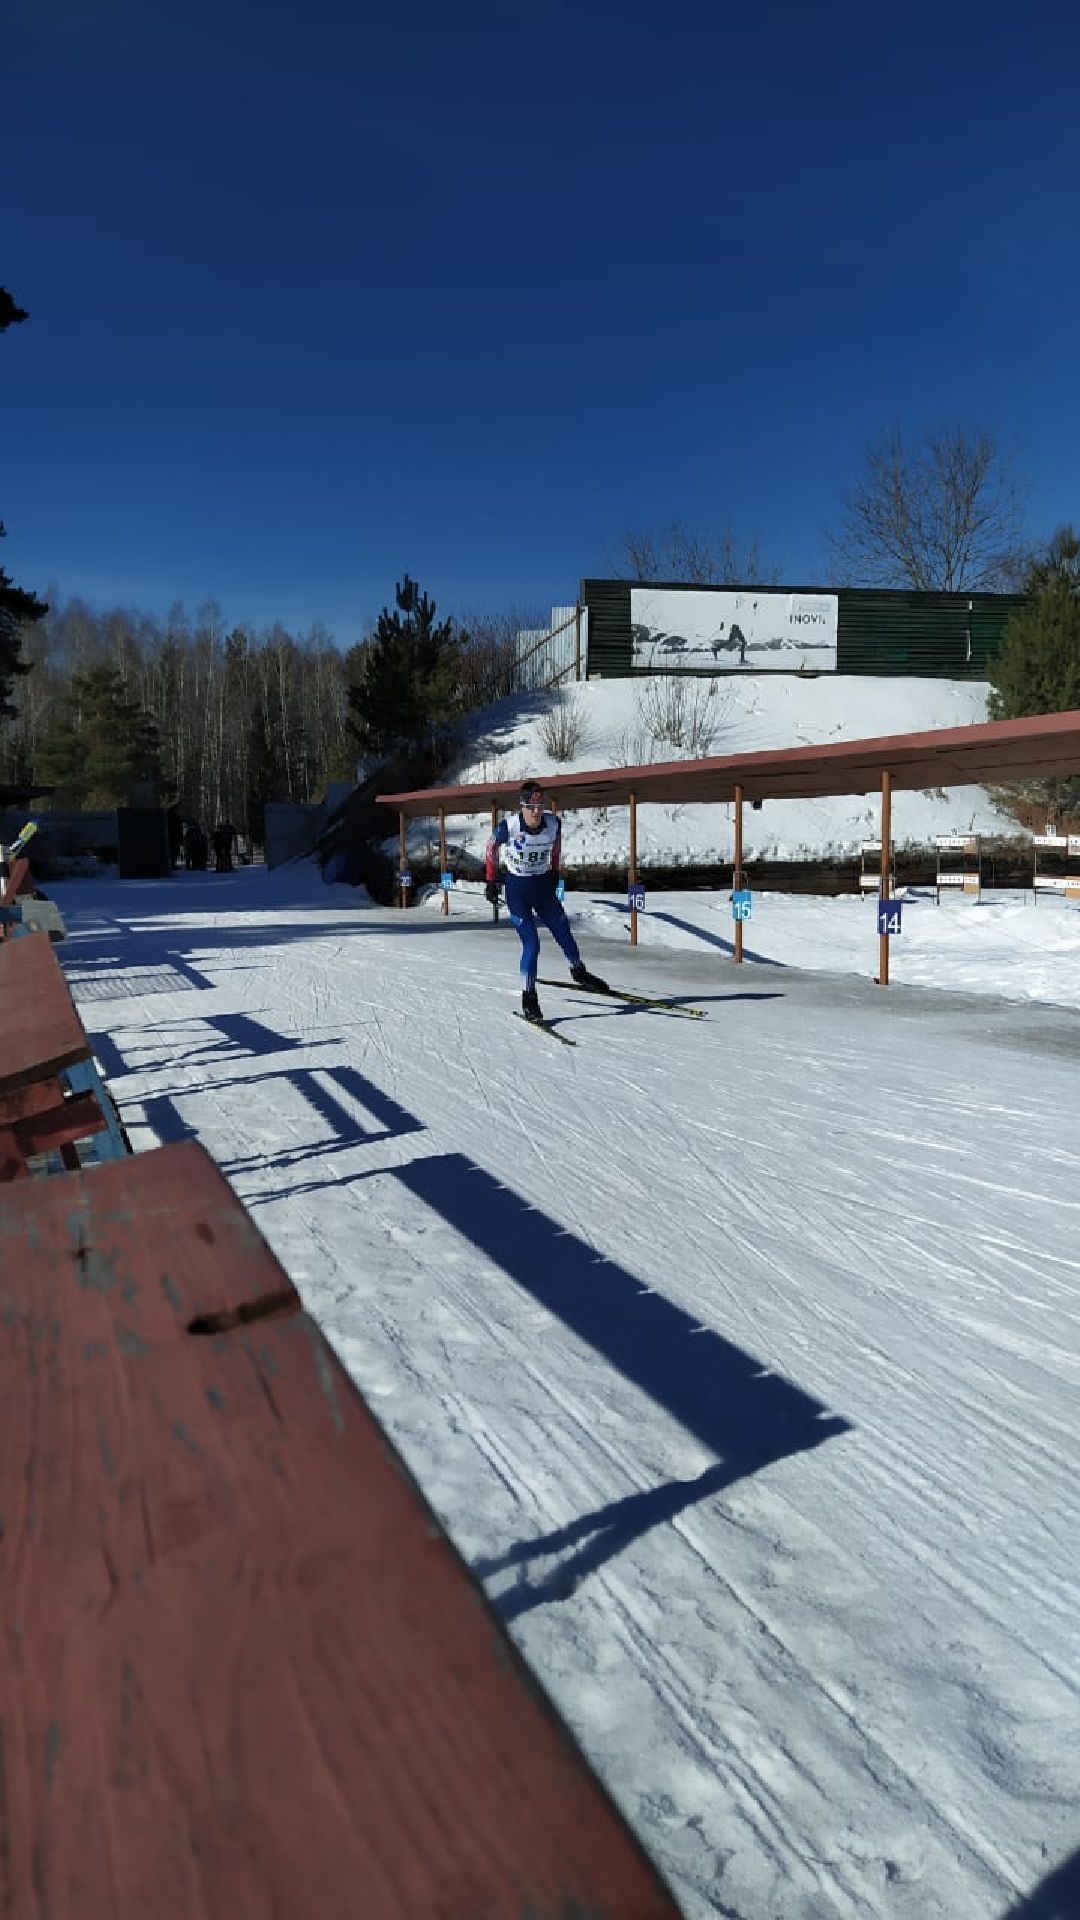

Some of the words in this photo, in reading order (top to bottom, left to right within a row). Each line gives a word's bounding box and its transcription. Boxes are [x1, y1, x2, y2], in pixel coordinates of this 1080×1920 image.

[629, 894, 644, 910] 16
[735, 901, 751, 919] 15
[879, 912, 901, 934] 14
